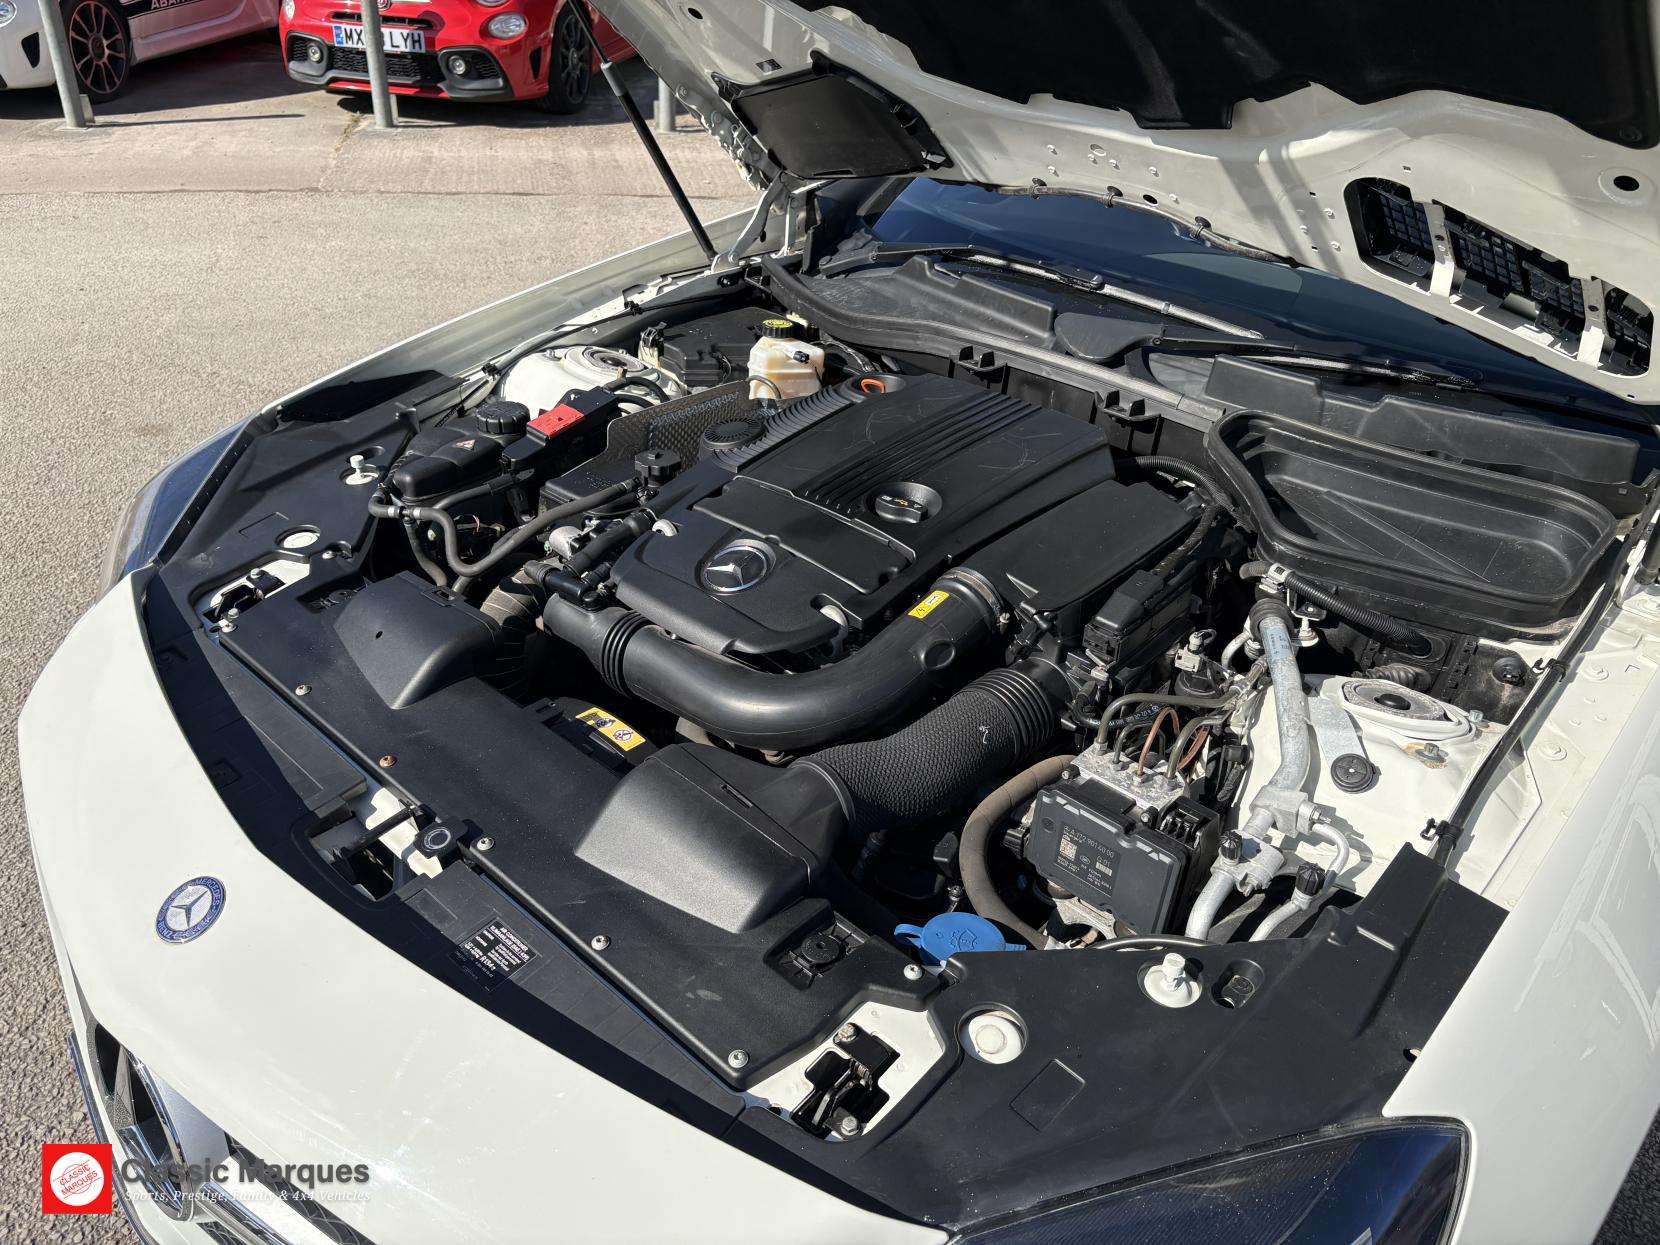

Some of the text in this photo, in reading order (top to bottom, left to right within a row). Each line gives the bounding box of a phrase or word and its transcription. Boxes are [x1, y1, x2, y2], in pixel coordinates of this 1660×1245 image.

[344, 27, 423, 50] MX LYH
[195, 877, 222, 907] MERCEDES
[157, 920, 173, 939] BENZ
